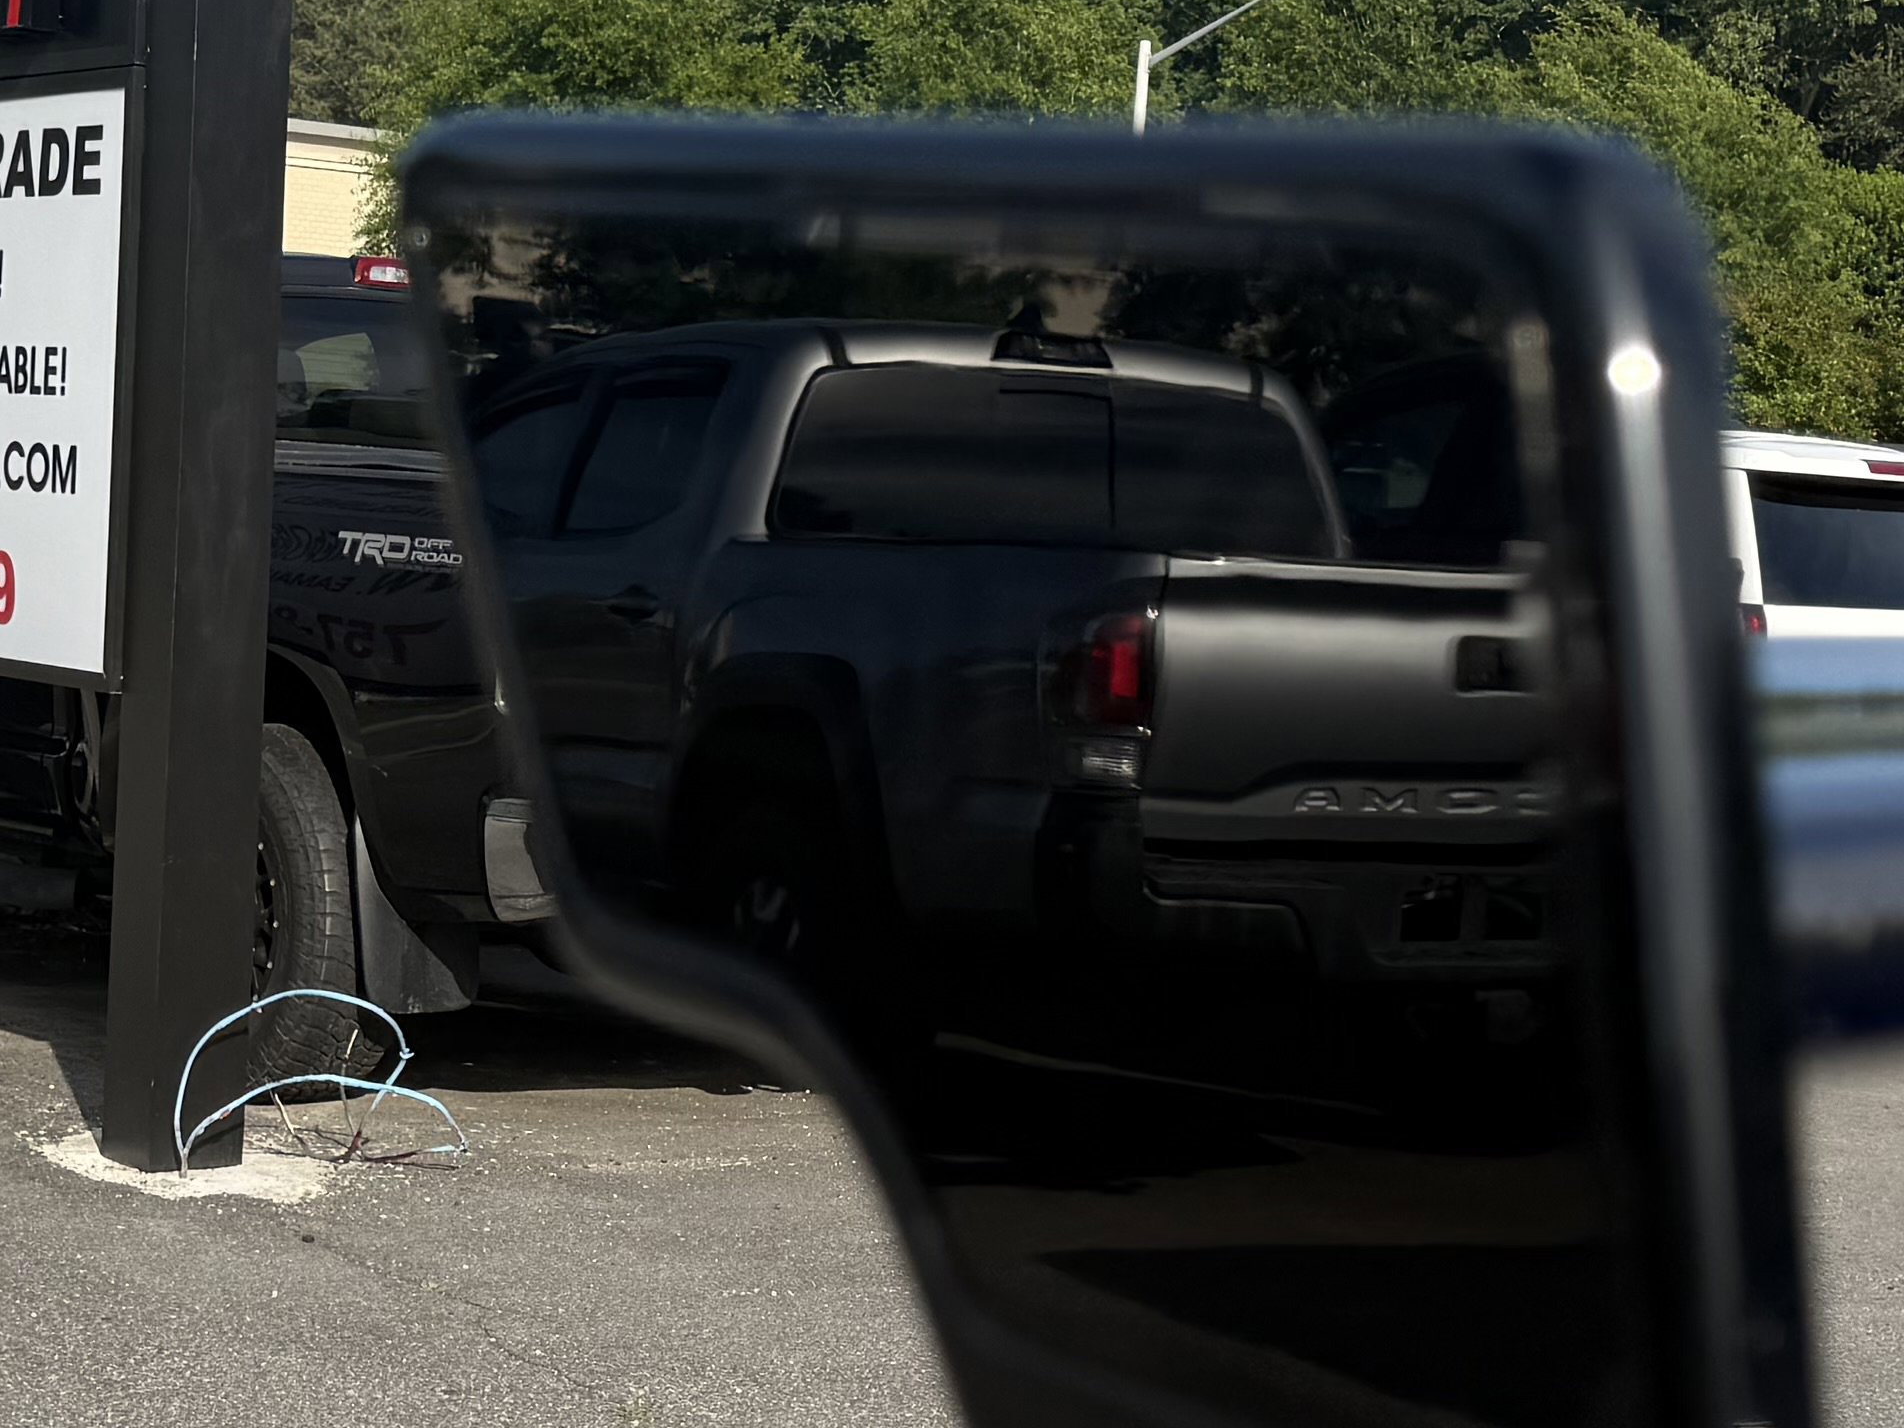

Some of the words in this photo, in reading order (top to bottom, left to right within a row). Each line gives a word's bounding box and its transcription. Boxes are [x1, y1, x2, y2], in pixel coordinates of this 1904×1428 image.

[338, 530, 411, 567] TRD
[414, 537, 454, 550] OFF
[410, 550, 463, 565] ROAD
